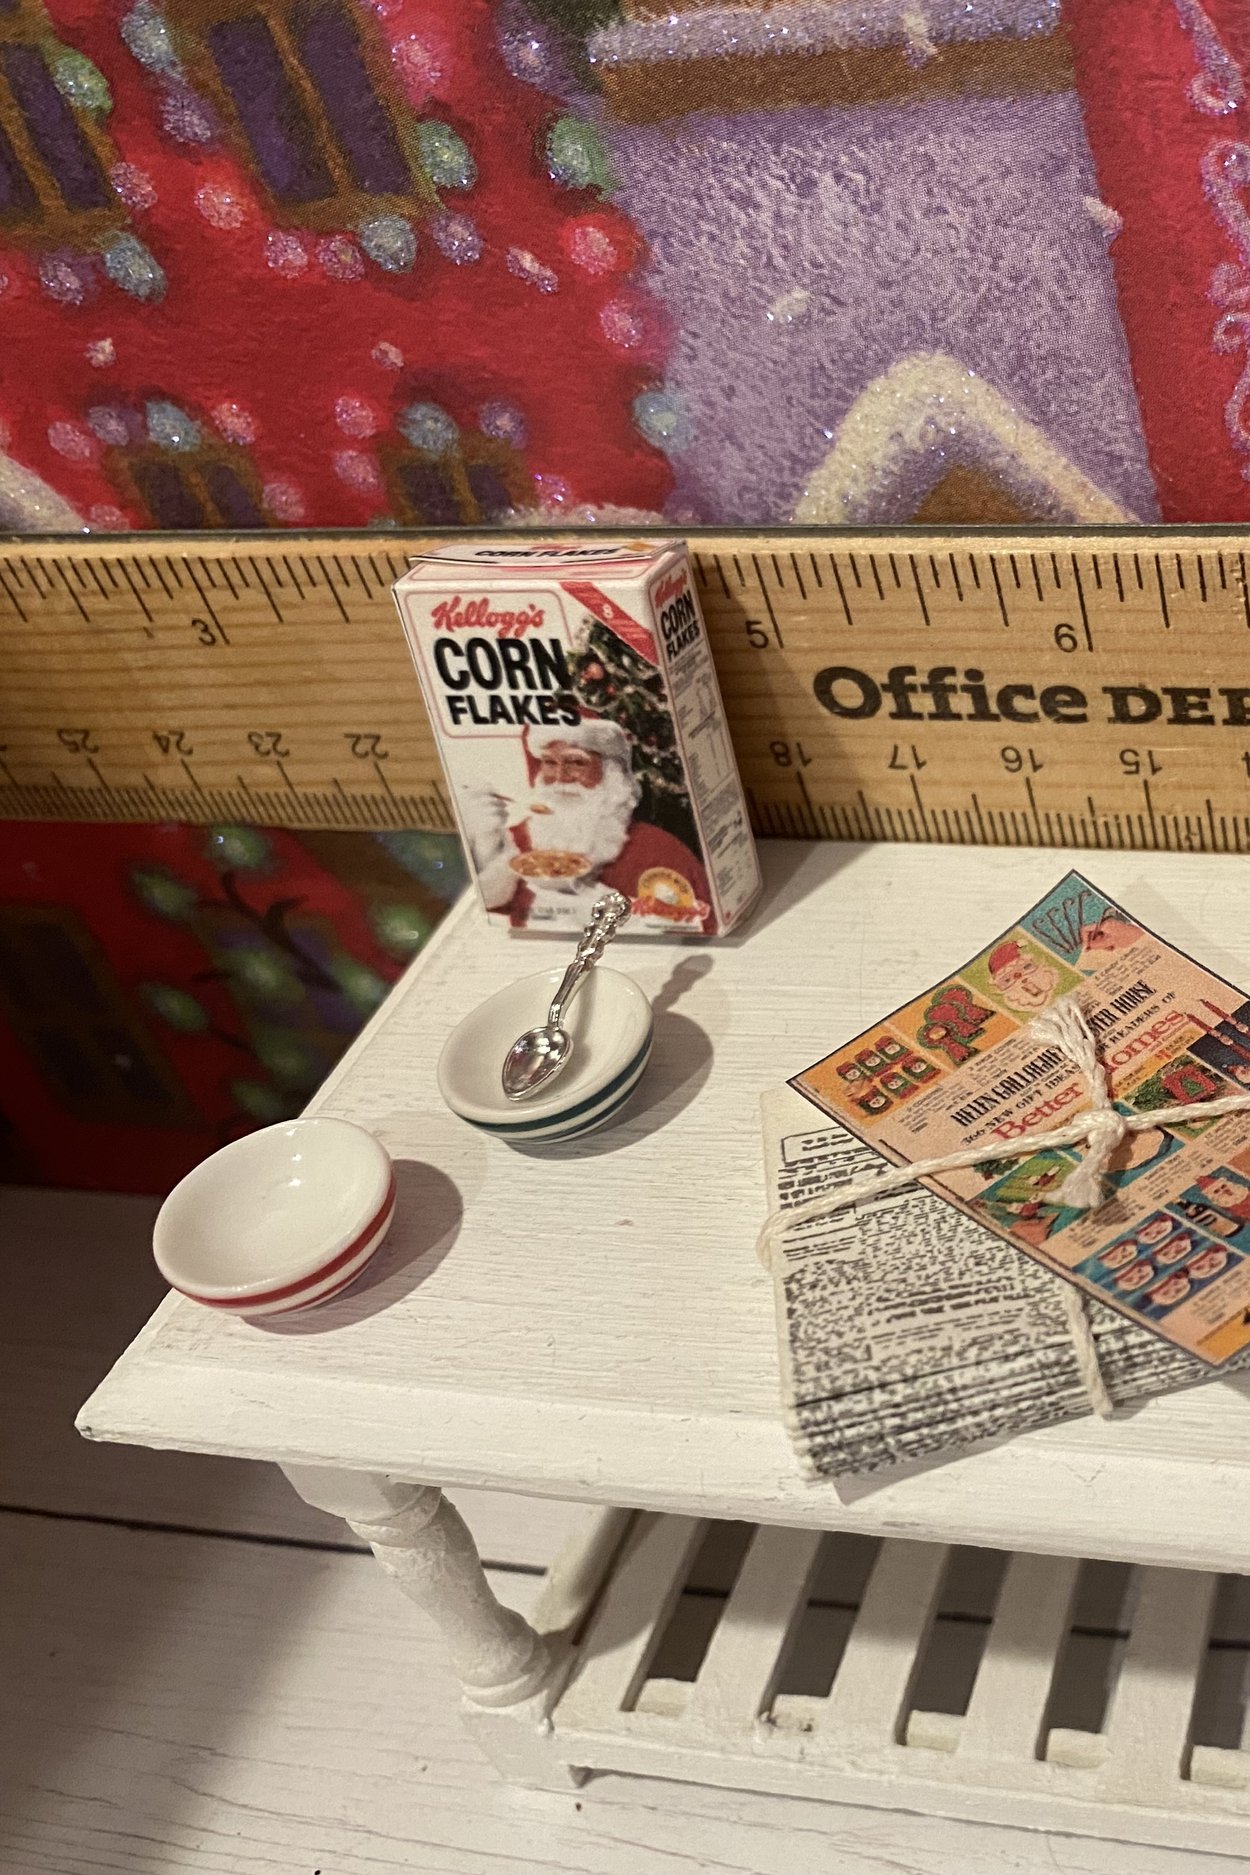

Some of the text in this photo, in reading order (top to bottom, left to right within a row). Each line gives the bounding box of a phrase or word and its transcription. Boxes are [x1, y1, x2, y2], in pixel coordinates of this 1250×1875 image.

[431, 596, 547, 638] Kellogg's
[661, 590, 697, 640] CORN
[191, 618, 217, 646] 3
[666, 620, 701, 663] FLAKES
[745, 620, 769, 648] 5
[1054, 623, 1079, 652] 6
[434, 637, 572, 690] CORN
[812, 665, 1088, 724] Office
[445, 695, 582, 727] FLAKES
[57, 729, 100, 753] 25
[152, 731, 194, 755] 24
[247, 732, 290, 757] 23
[343, 733, 389, 759] 22
[769, 741, 811, 767] 18
[888, 744, 927, 771] 17
[1001, 746, 1044, 773] 16
[1119, 749, 1163, 776] 15
[951, 1091, 998, 1127] HELEN
[1110, 978, 1157, 1013] HOUSE
[985, 1109, 1014, 1129] NEW
[1016, 1089, 1045, 1110] GIFT
[1045, 1063, 1082, 1089] IDEAS
[1111, 1005, 1161, 1043] READERS
[1160, 991, 1177, 1004] OF
[991, 1081, 1087, 1140] Better
